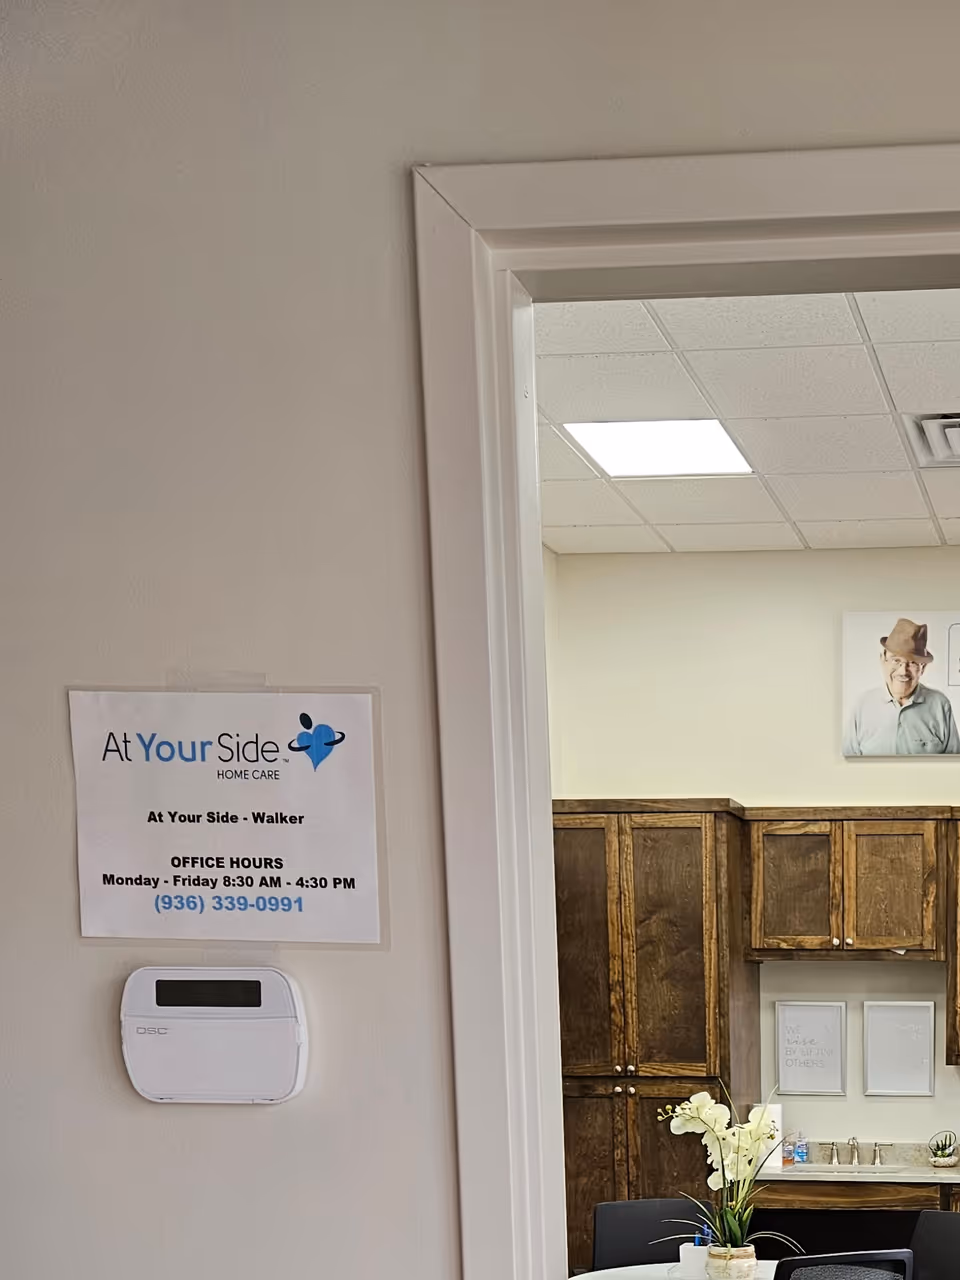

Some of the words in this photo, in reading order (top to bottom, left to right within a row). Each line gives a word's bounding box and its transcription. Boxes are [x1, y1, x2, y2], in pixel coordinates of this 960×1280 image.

[102, 731, 132, 762] At
[136, 732, 213, 762] Your
[217, 732, 280, 763] Side
[217, 769, 249, 780] HOME
[252, 770, 280, 780] CARE
[147, 811, 163, 823] At
[167, 811, 202, 823] Your
[206, 811, 239, 823] Side
[251, 811, 305, 824] Walker
[170, 856, 225, 869] OFFICE
[229, 857, 284, 869] HOURS
[102, 873, 160, 889] Monday
[173, 874, 218, 889] Friday
[222, 875, 254, 887] 8:30
[258, 876, 282, 888] AM
[295, 877, 328, 889] 4:30
[333, 878, 356, 889] PM
[154, 894, 205, 914] (936)
[212, 895, 304, 912] 339-0991
[136, 1026, 168, 1035] DSC
